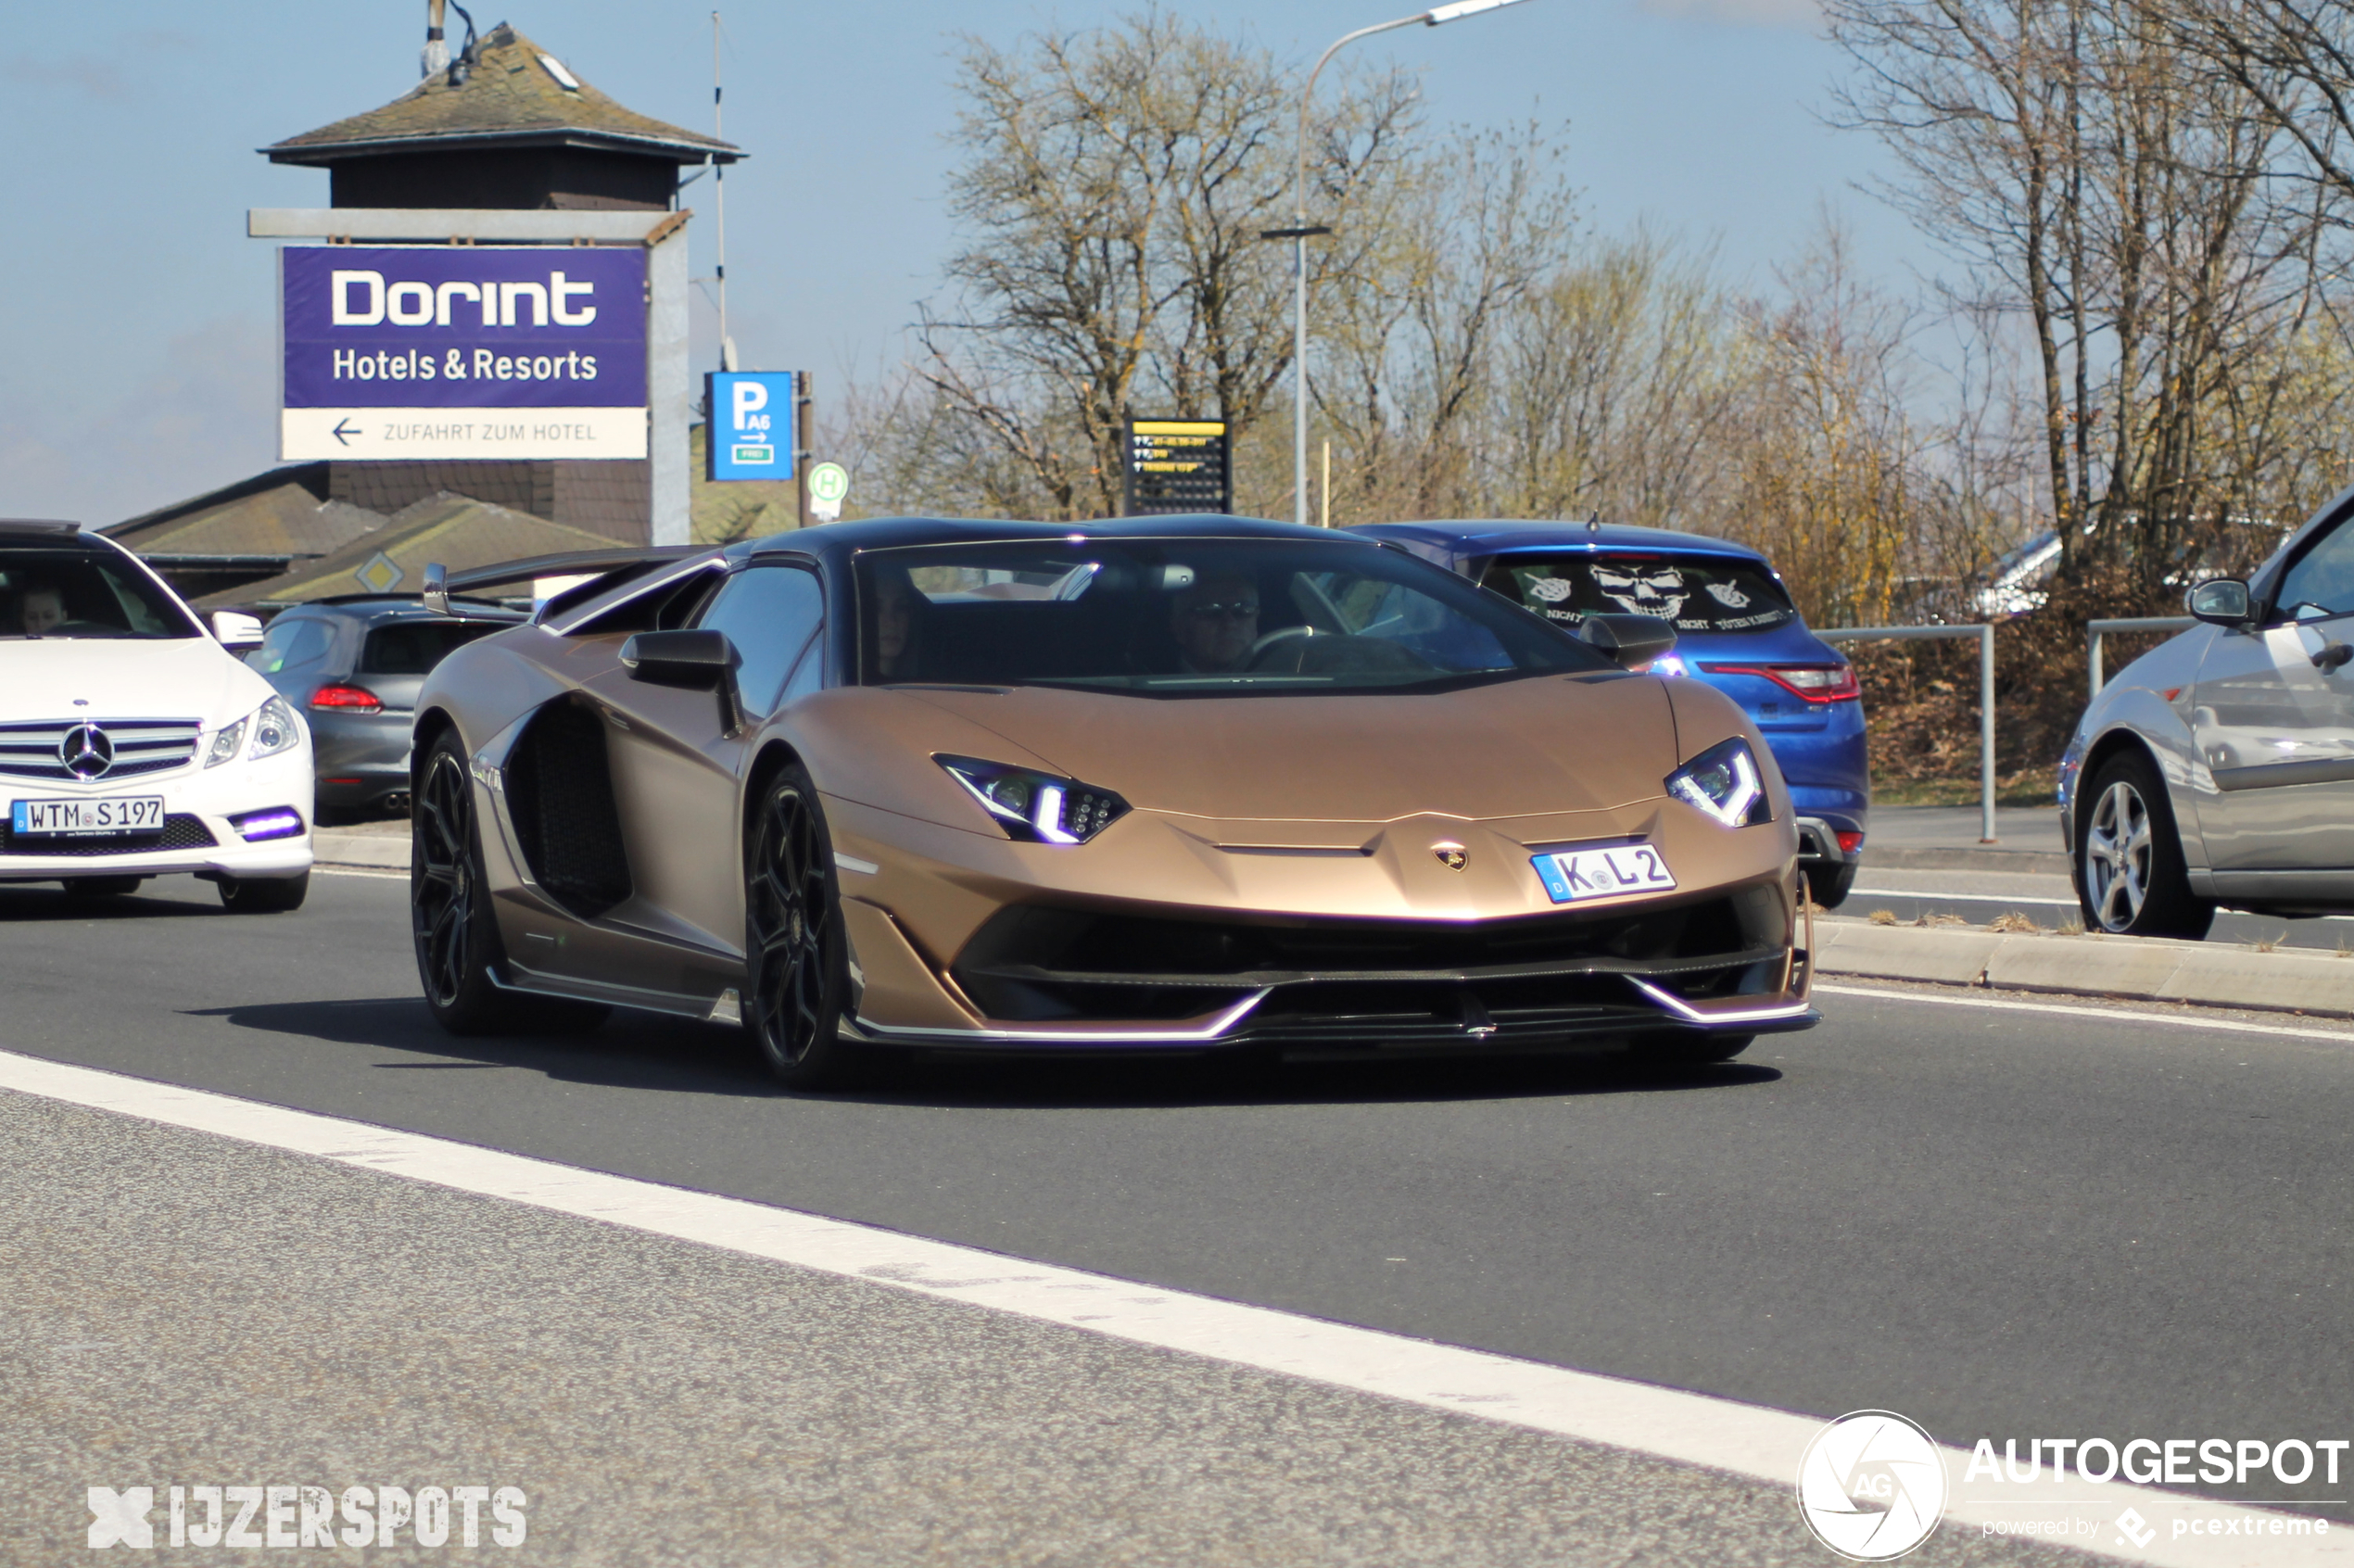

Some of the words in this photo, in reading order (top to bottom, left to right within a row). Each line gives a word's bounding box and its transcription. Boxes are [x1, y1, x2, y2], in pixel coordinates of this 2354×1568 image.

[332, 270, 597, 326] Dorint
[333, 348, 436, 381] Hotels
[444, 348, 467, 381] &
[474, 348, 598, 381] Resorts
[732, 381, 768, 430] P
[384, 424, 475, 441] ZUFAHRT
[483, 424, 525, 441] ZUM
[534, 424, 598, 441] HOTEL
[747, 414, 771, 430] A6
[820, 473, 838, 494] H
[1546, 609, 1586, 623] NICHT
[1677, 619, 1710, 629] NICHT
[31, 803, 80, 828] WTM
[1552, 882, 1563, 892] D
[1558, 856, 1594, 891] K
